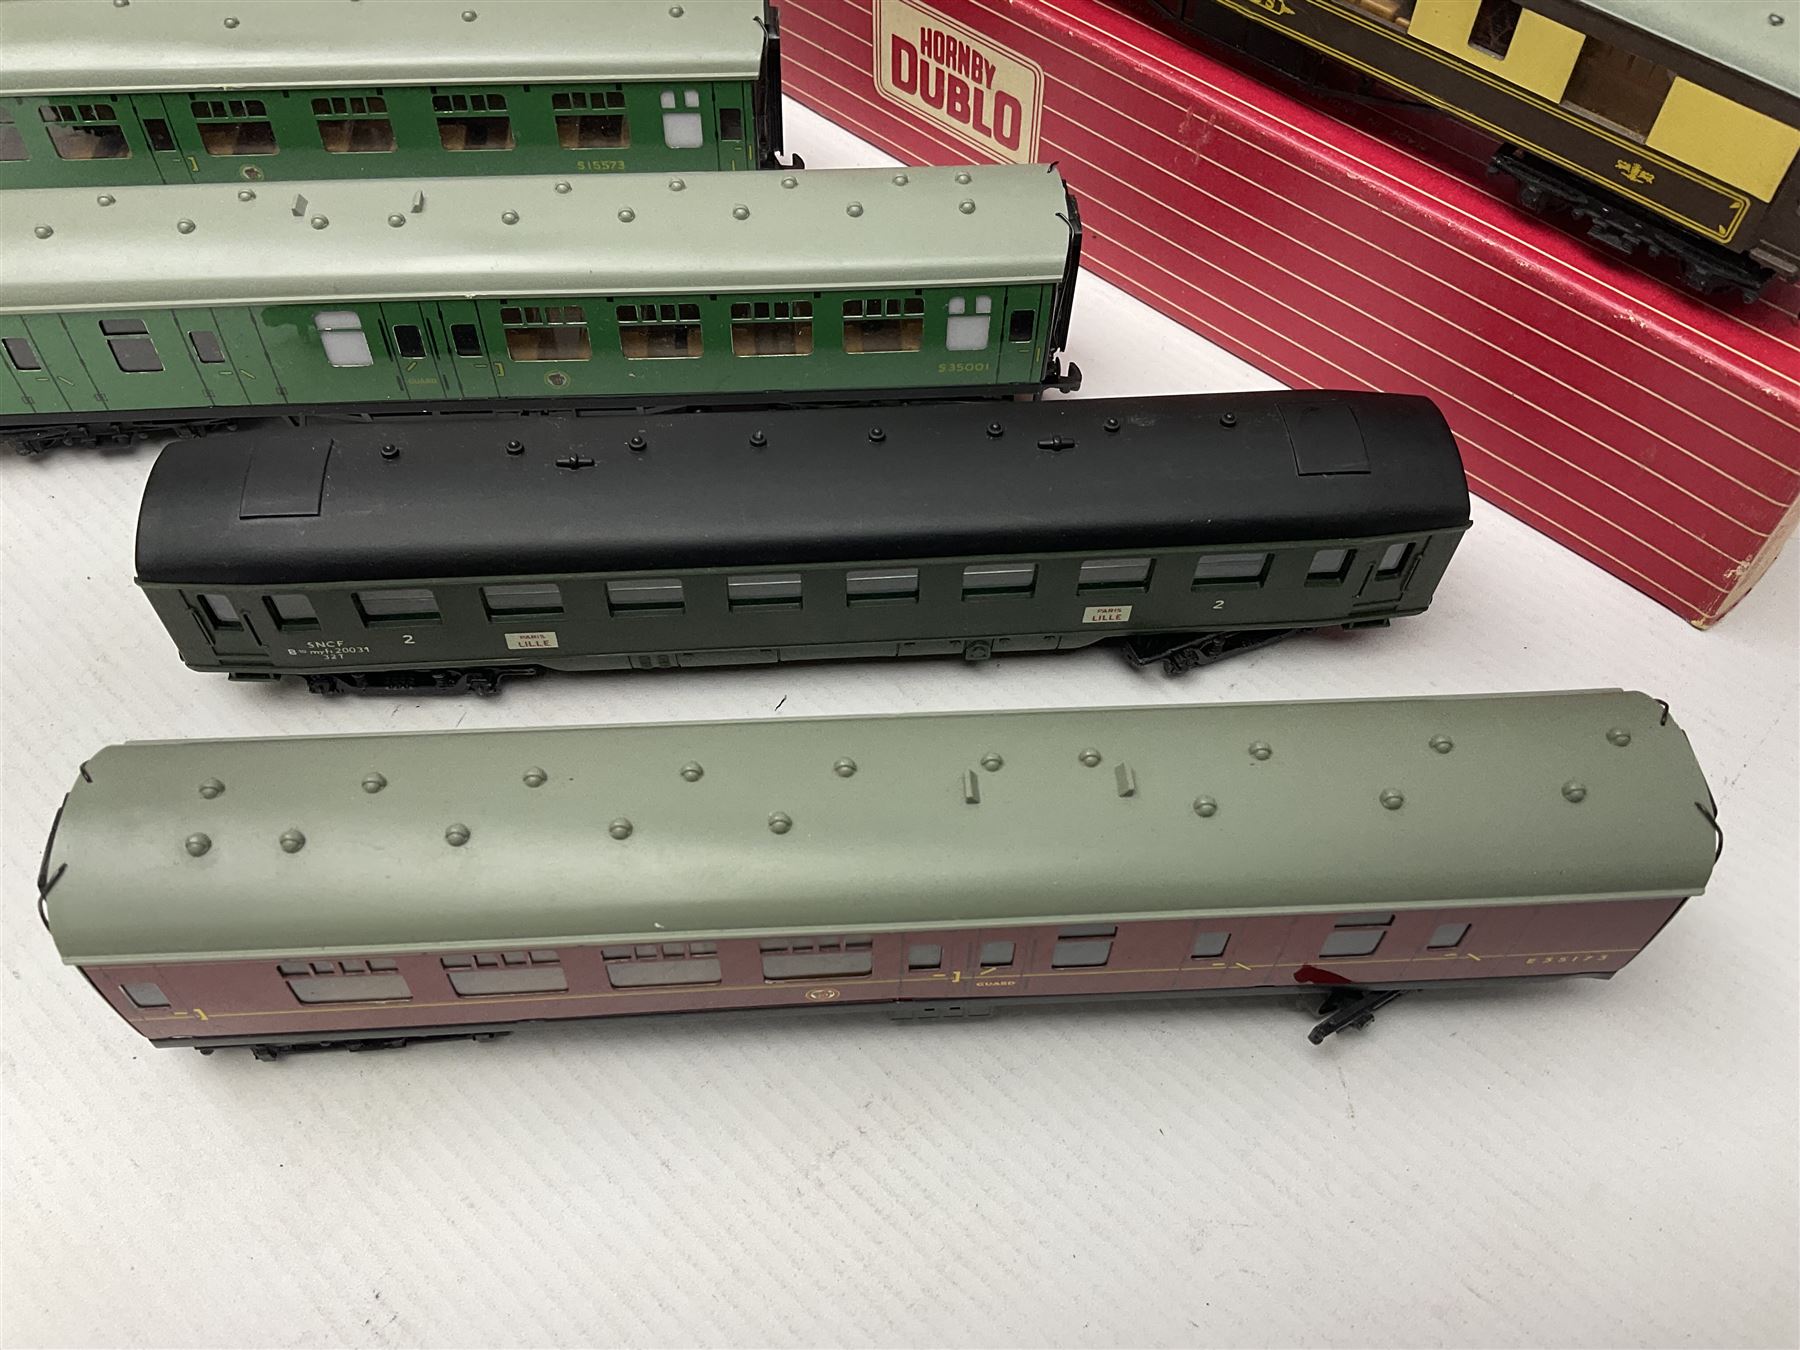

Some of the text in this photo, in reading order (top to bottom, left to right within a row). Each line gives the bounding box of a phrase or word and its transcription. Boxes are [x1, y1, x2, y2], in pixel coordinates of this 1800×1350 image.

[920, 26, 997, 90] HORNBY
[891, 33, 1022, 151] DUBLO
[576, 160, 625, 170] S15573
[938, 362, 990, 373] S35001
[1213, 599, 1225, 609] 2
[1092, 613, 1122, 622] LILLE
[306, 640, 344, 648] SNCF
[402, 634, 416, 644] 2
[518, 640, 552, 648] LILLE
[1526, 954, 1609, 965] E35173
